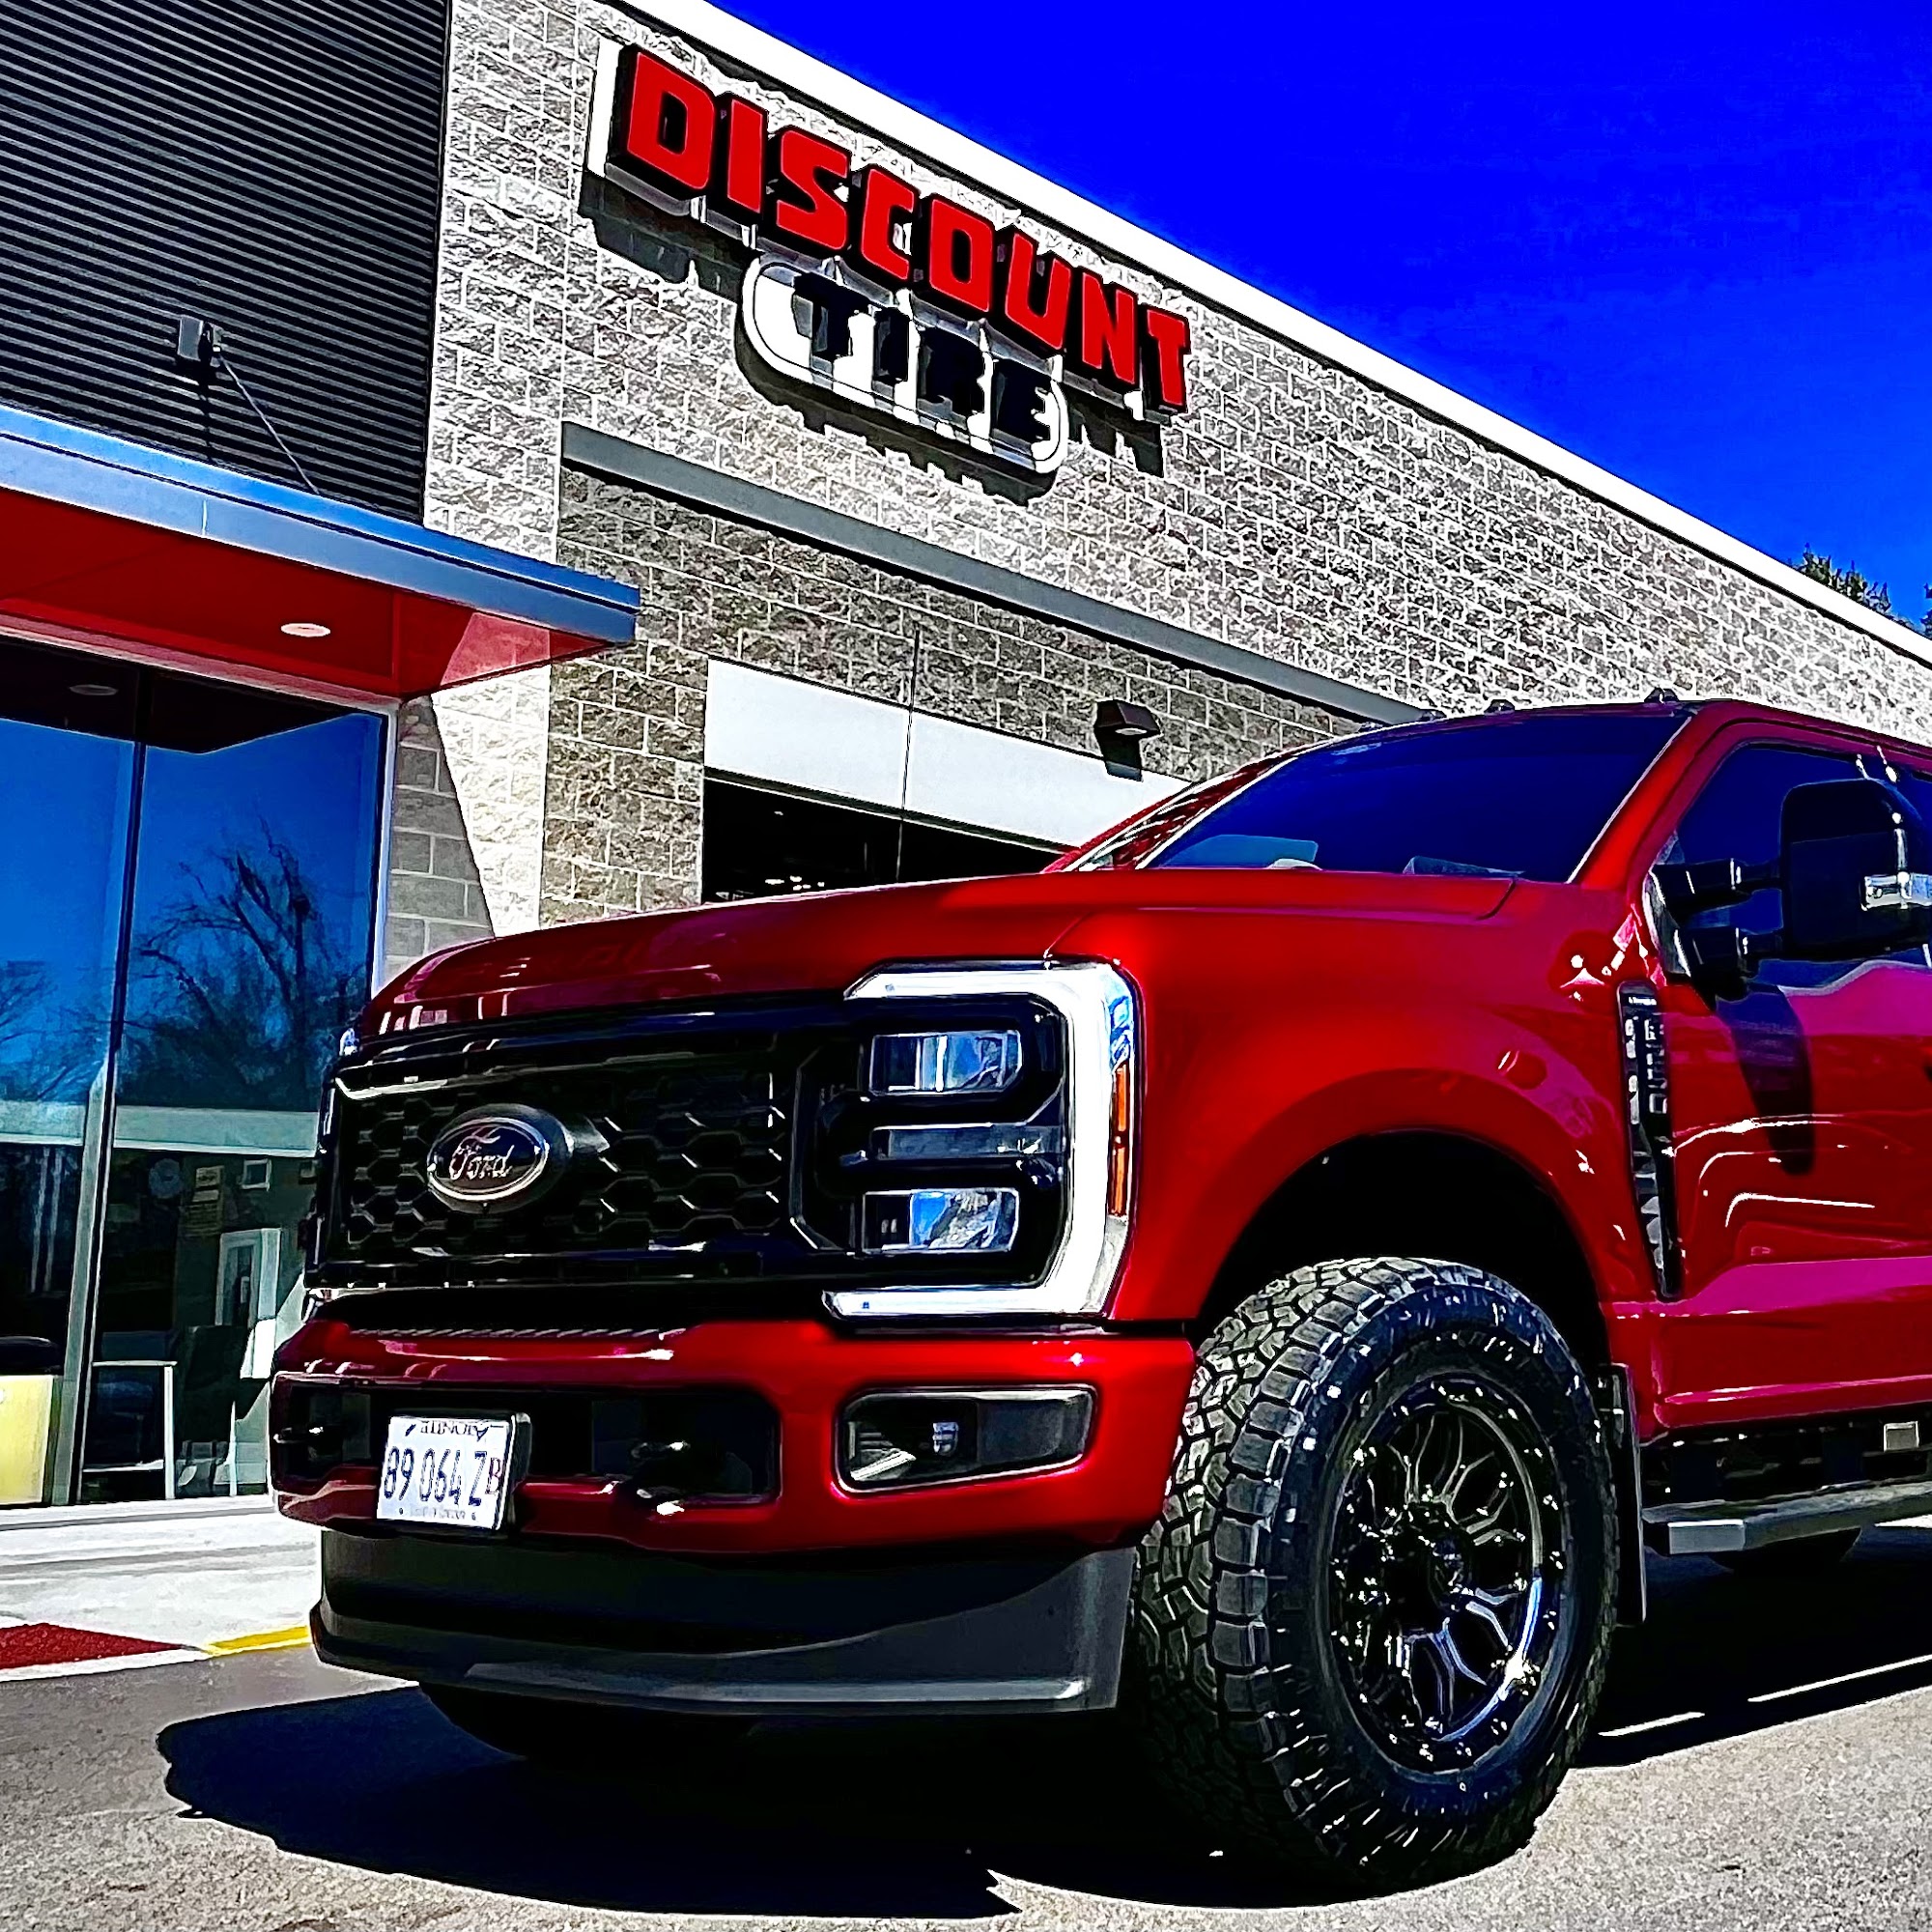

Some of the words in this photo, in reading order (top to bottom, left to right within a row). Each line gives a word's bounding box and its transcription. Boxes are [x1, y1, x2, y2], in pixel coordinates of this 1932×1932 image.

[624, 48, 1190, 411] DISCOUNT
[790, 272, 1056, 444] TIRE
[448, 1133, 515, 1180] Ford
